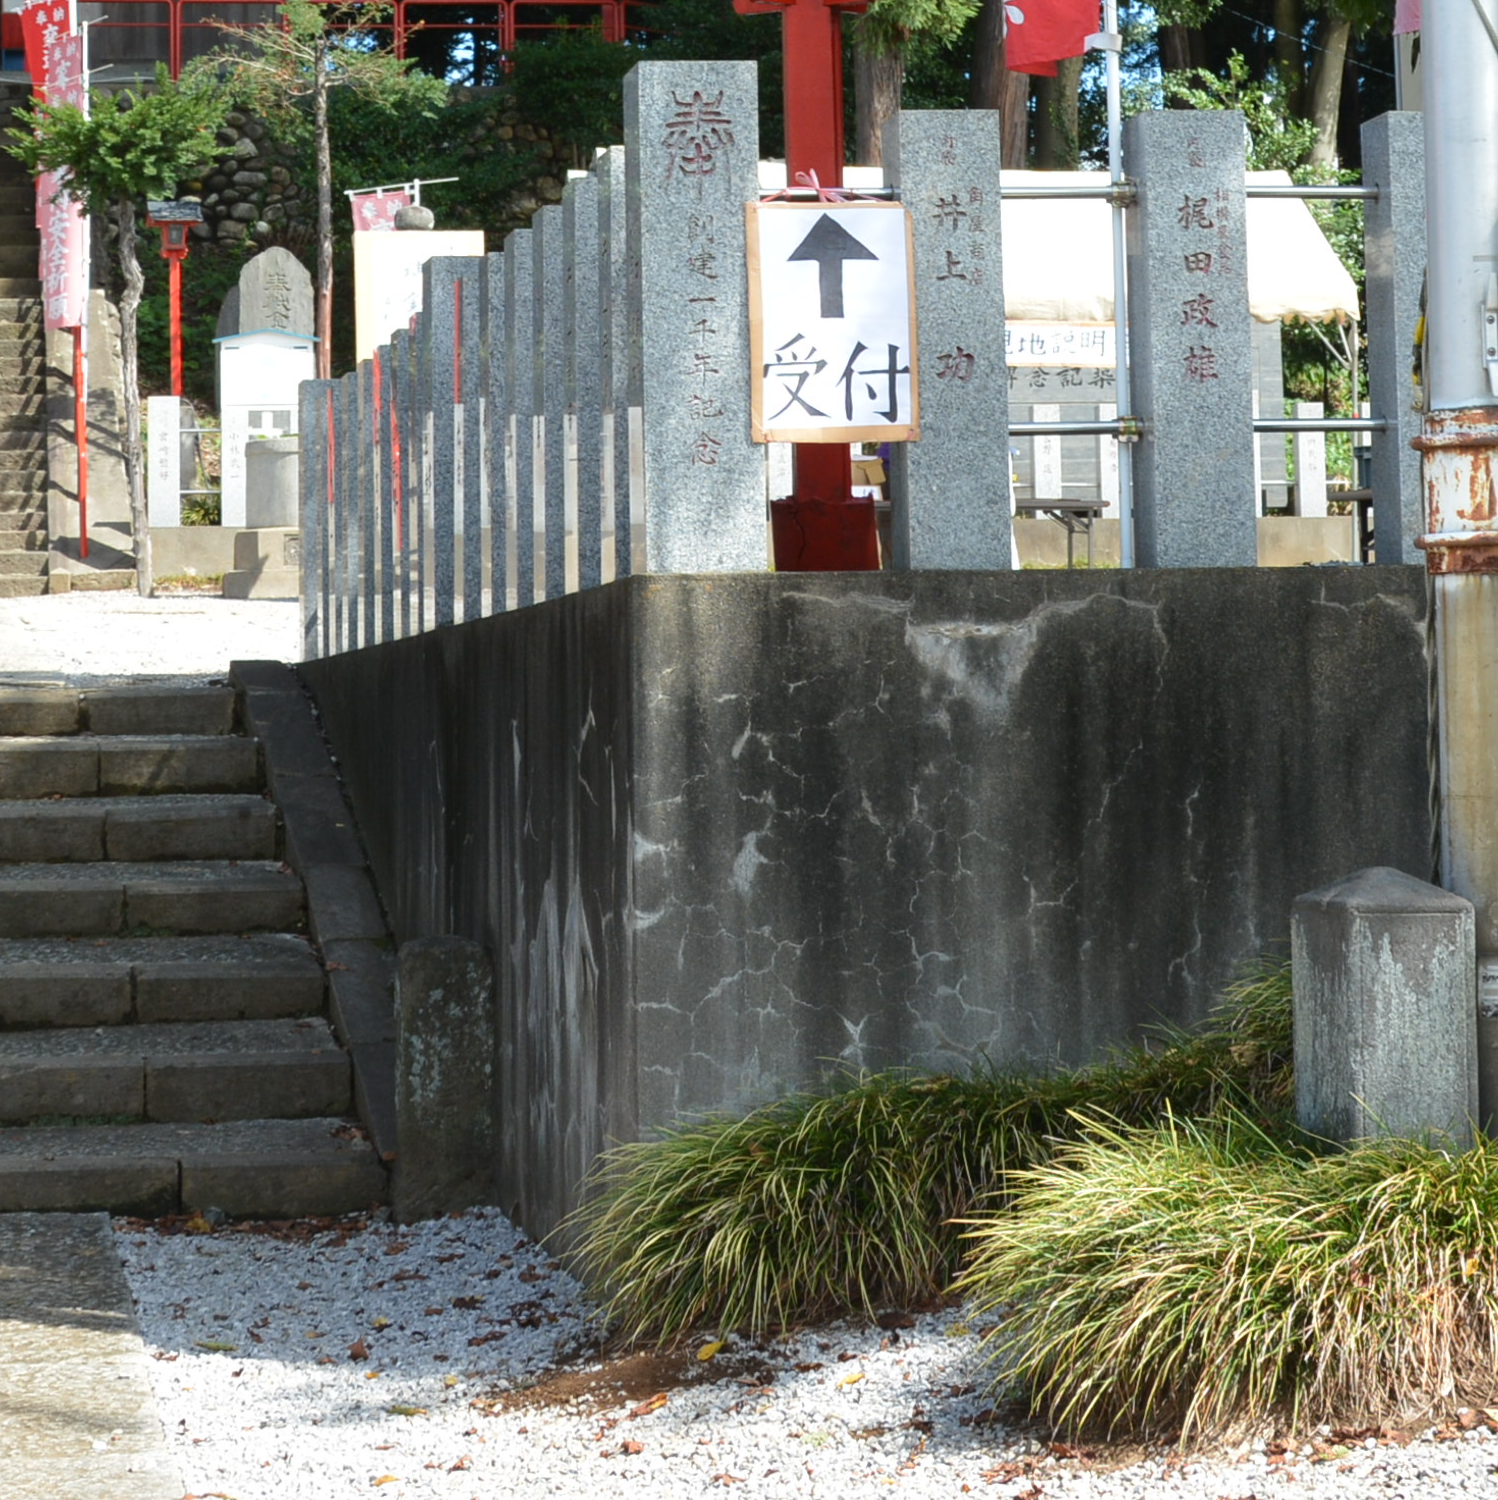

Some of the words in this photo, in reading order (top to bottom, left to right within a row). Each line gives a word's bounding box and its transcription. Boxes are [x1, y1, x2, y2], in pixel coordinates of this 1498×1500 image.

[36, 6, 65, 26] 奉納
[931, 193, 976, 382] 井上功
[762, 332, 911, 424] 受付
